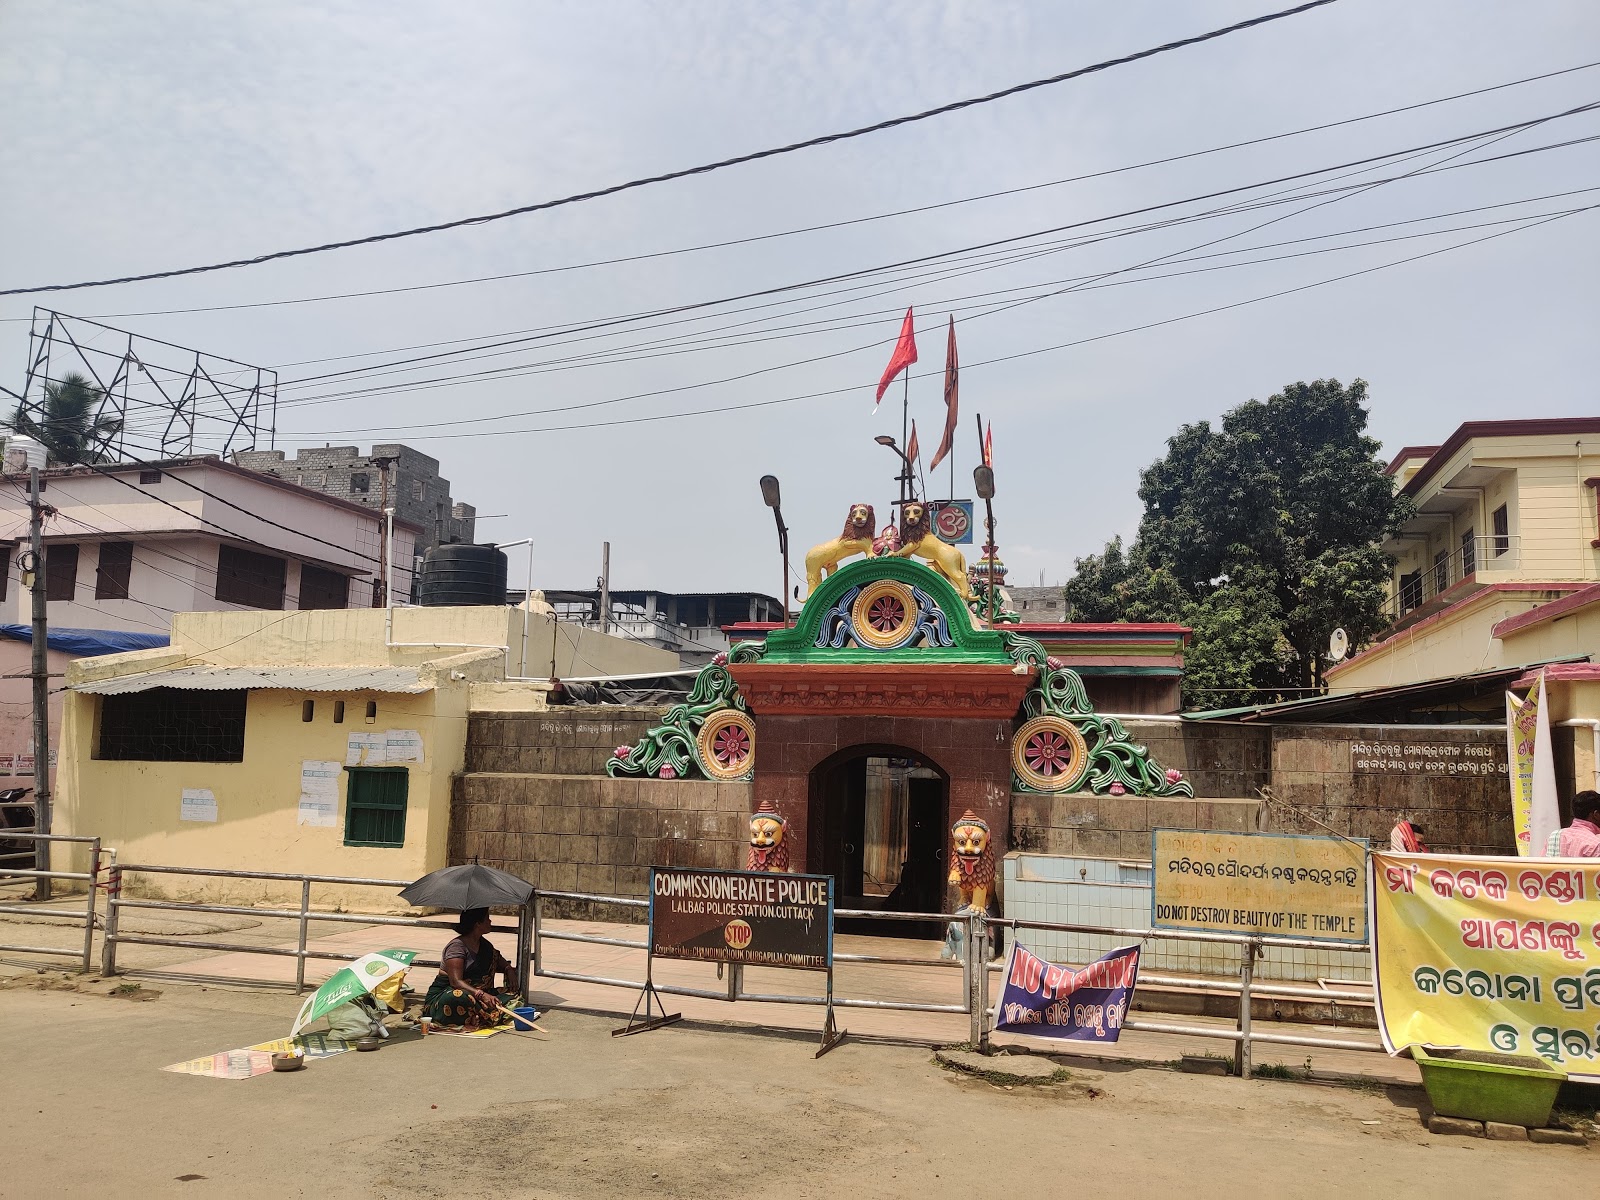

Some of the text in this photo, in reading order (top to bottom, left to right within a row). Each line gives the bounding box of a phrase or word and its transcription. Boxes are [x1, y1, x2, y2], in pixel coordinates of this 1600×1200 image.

[654, 873, 828, 906] COMMISSIONERATE POLICE
[1430, 869, 1508, 899] କଟକ
[1519, 871, 1584, 902] ଚଣ୍ଡୀ
[671, 899, 705, 914] LALBAG
[1157, 904, 1355, 933] DO NOT DESTROY BEAUTY OF THE TEMPLE
[725, 924, 752, 944] STOP
[784, 952, 825, 967] COMMITTEE
[1010, 947, 1043, 994] NO
[1414, 966, 1542, 1003] କରୋନା
[1490, 1023, 1519, 1052] ଓ
